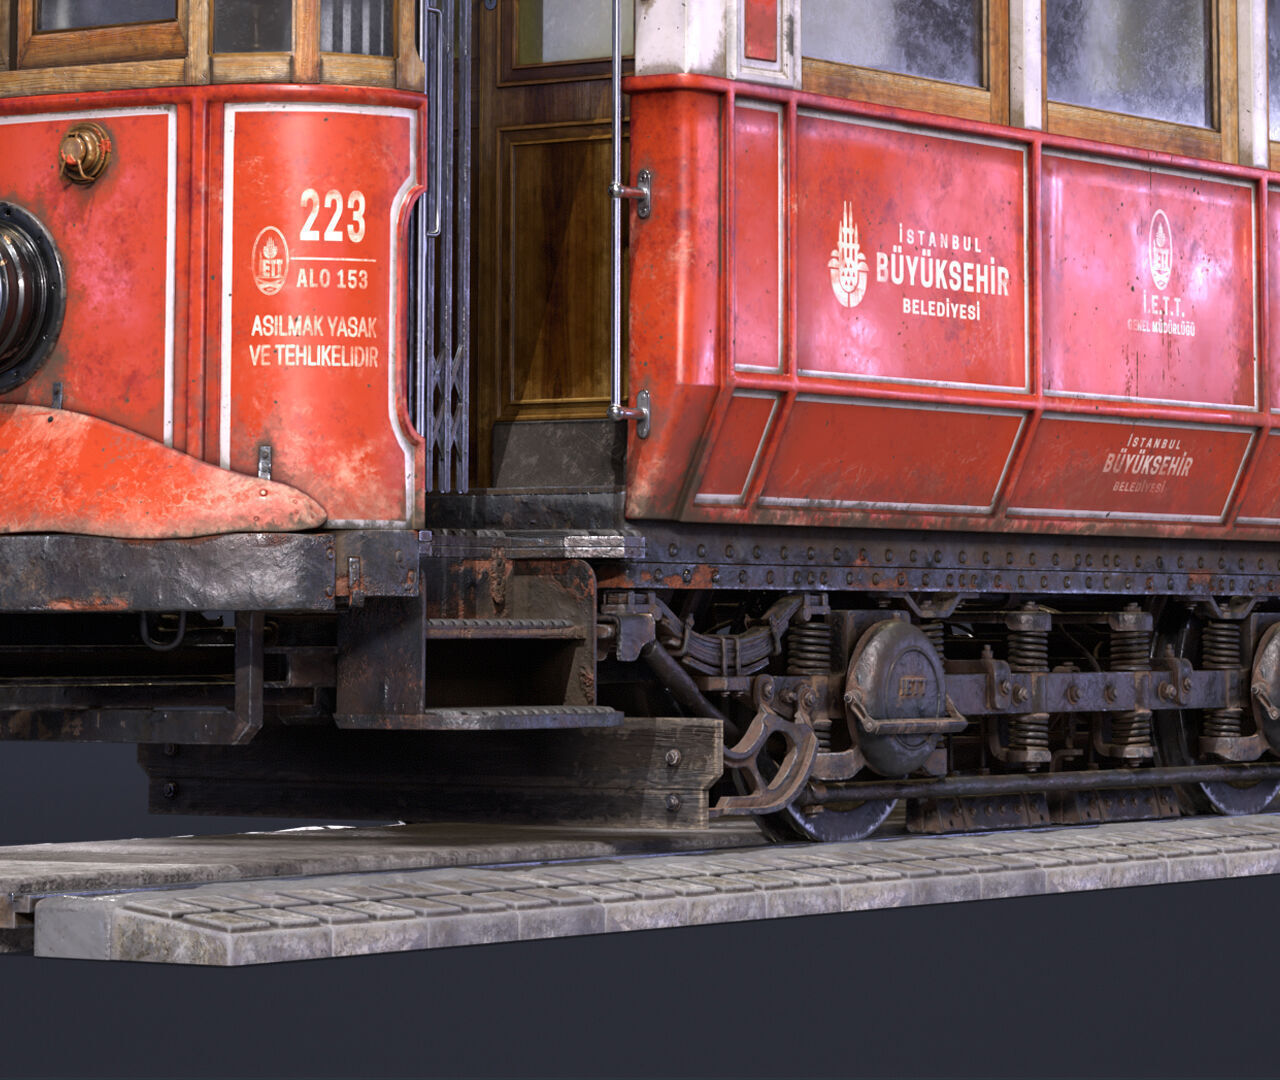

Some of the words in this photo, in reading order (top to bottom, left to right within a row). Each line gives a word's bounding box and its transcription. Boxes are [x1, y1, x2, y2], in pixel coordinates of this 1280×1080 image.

[299, 188, 366, 243] 223
[899, 223, 982, 253] İSTANBUL
[296, 268, 331, 288] ALO
[337, 270, 369, 290] 153
[902, 298, 981, 321] BELEDİYESİ
[251, 314, 324, 337] ASILMAK
[327, 316, 377, 338] YASAK
[249, 344, 271, 366] VE
[1126, 433, 1181, 450] İSTANBUL
